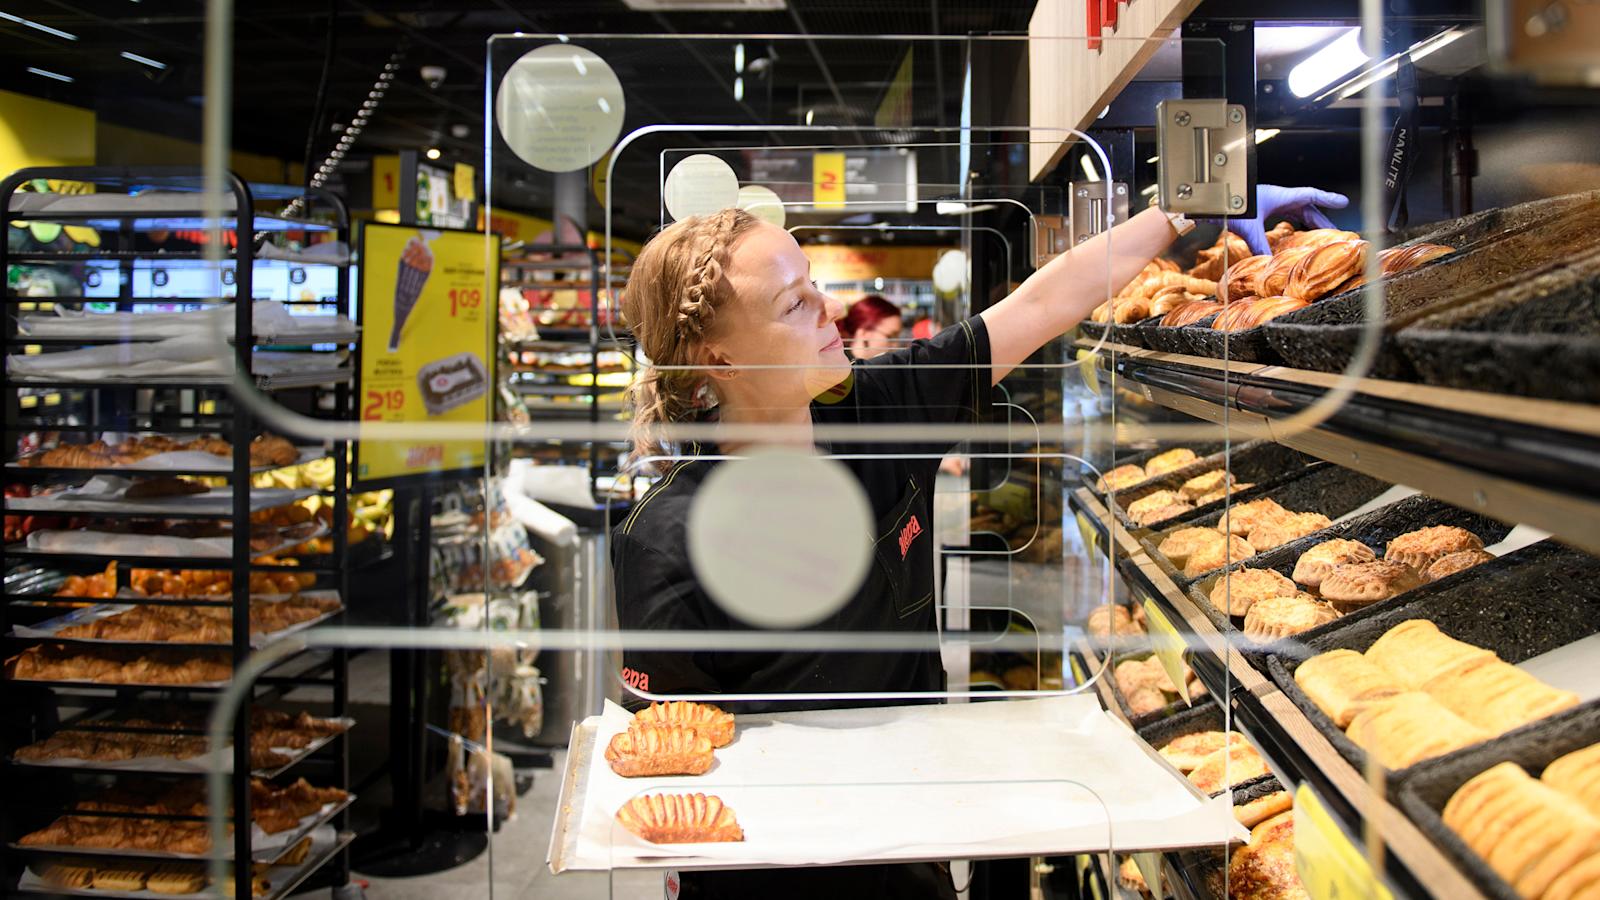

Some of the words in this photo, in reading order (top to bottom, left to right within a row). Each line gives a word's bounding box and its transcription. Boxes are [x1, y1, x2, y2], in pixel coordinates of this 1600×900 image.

[1385, 128, 1407, 189] NANLITE
[819, 172, 837, 190] 2
[899, 515, 921, 558] alepa
